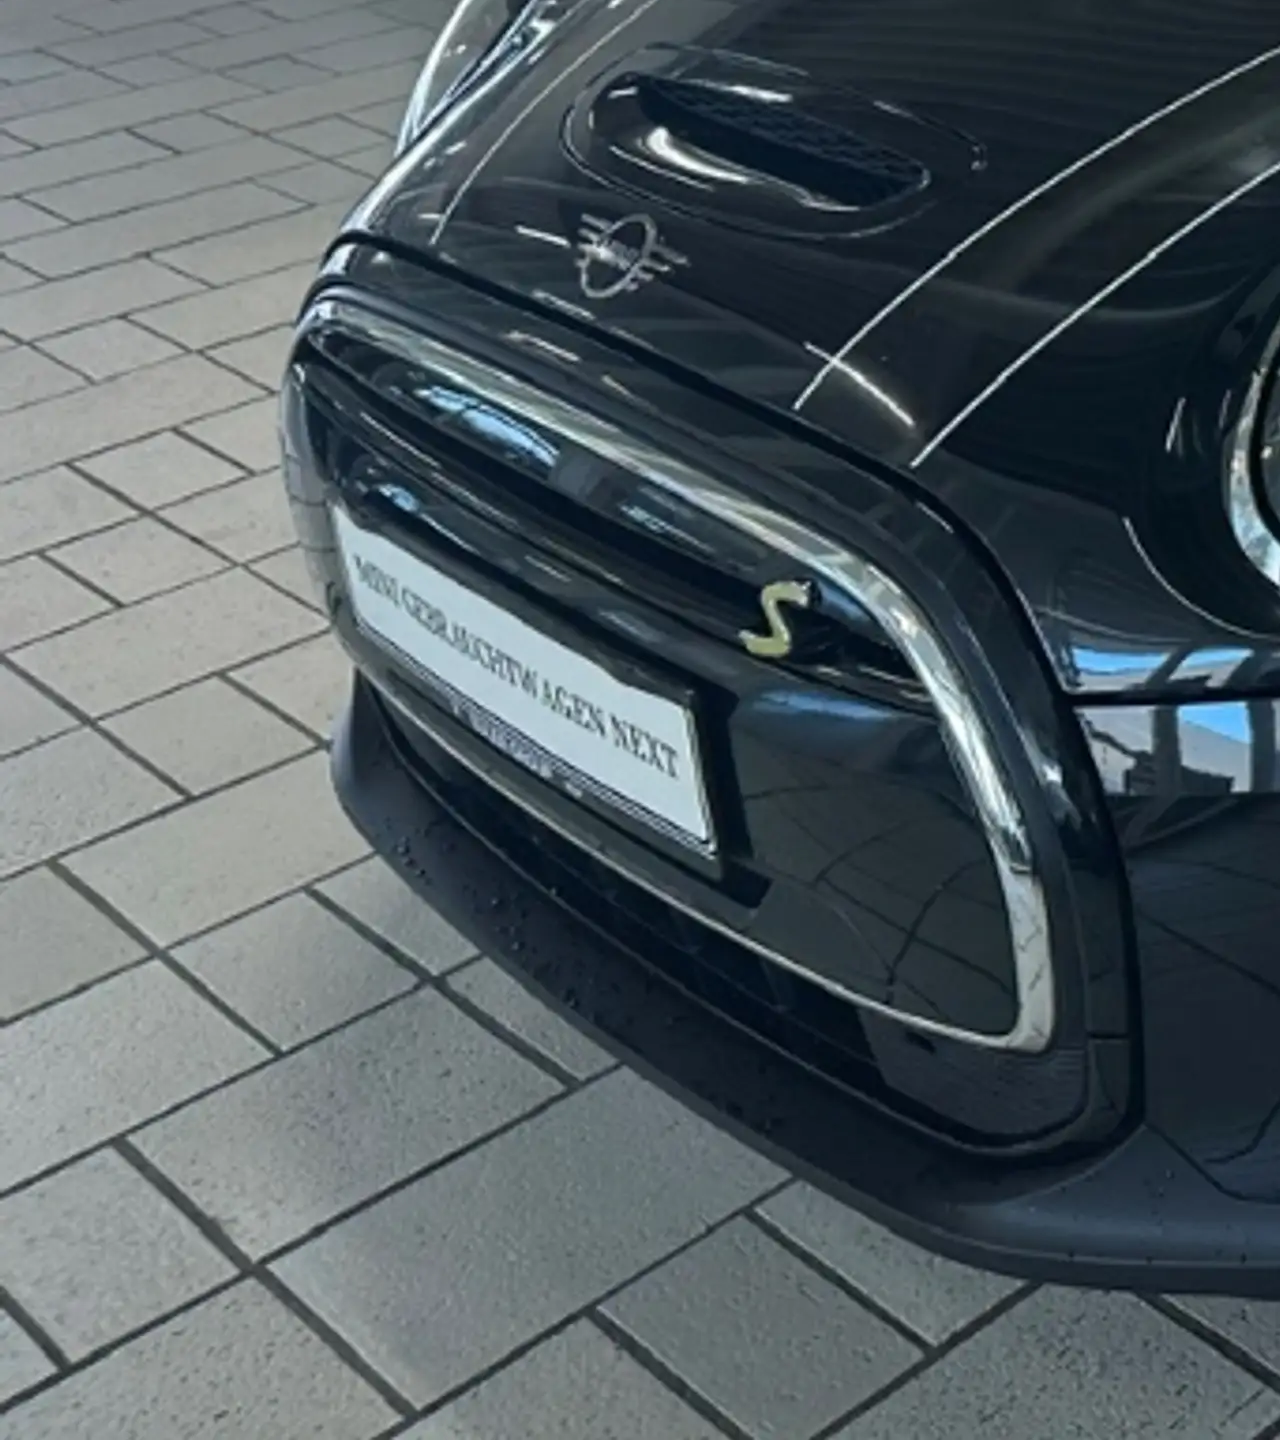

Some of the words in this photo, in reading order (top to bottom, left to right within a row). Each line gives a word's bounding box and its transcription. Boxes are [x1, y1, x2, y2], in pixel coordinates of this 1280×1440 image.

[354, 553, 399, 607] MINI
[610, 712, 678, 778] NEXT
[739, 581, 811, 657] S
